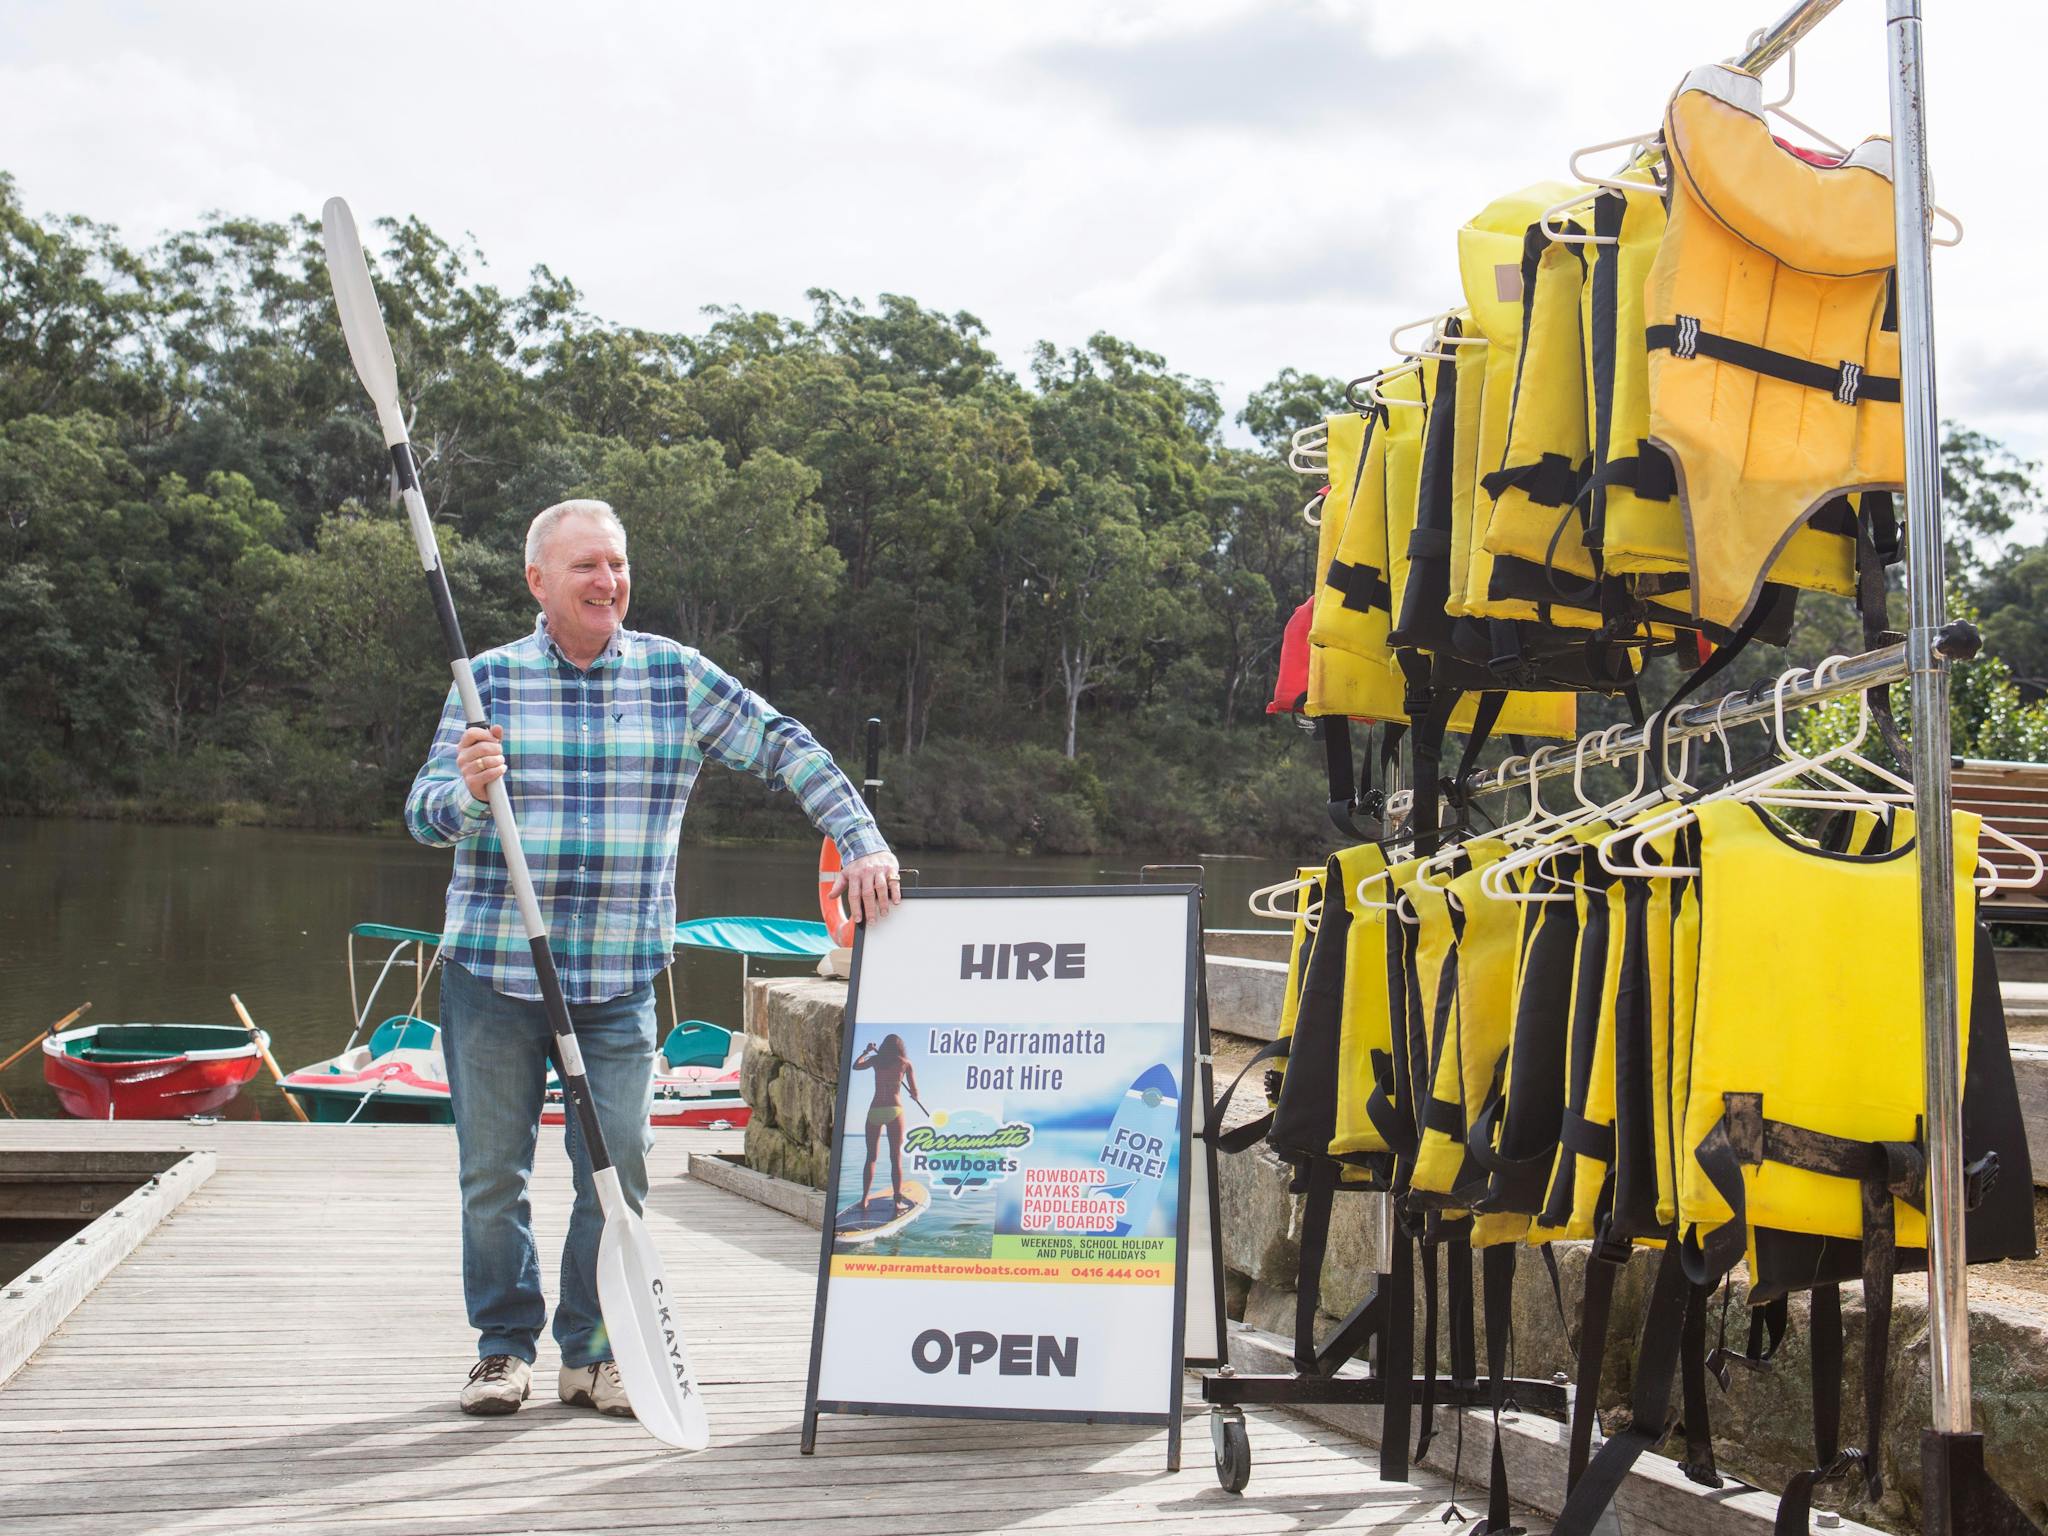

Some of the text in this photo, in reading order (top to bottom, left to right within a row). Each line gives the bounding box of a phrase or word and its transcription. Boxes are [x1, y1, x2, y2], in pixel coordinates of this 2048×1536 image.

[960, 941, 1086, 982] HIRE
[929, 1029, 1106, 1055] Lake Parramatta
[966, 1065, 1063, 1091] Boat Hire
[904, 1124, 1030, 1153] Parramatta
[1114, 1128, 1163, 1157] FOR
[914, 1155, 1018, 1172] Rowboats
[1100, 1145, 1166, 1179] HIRE!
[1026, 1169, 1105, 1183] ROWBOATS
[1025, 1184, 1080, 1198] KAYAKS
[1024, 1200, 1126, 1214] PADDLEBOATS
[1023, 1215, 1115, 1230] SUP BOARDS
[1021, 1238, 1164, 1250] WEEKENDS, SCHOOL HOLIDAY
[1036, 1249, 1146, 1260] AND PUBLIC HOLIDAYS
[845, 1261, 1160, 1279] www.parramattarowboats.com.au 0416 444 001
[651, 1278, 693, 1399] C-KAYAK
[911, 1328, 1079, 1378] OPEN
